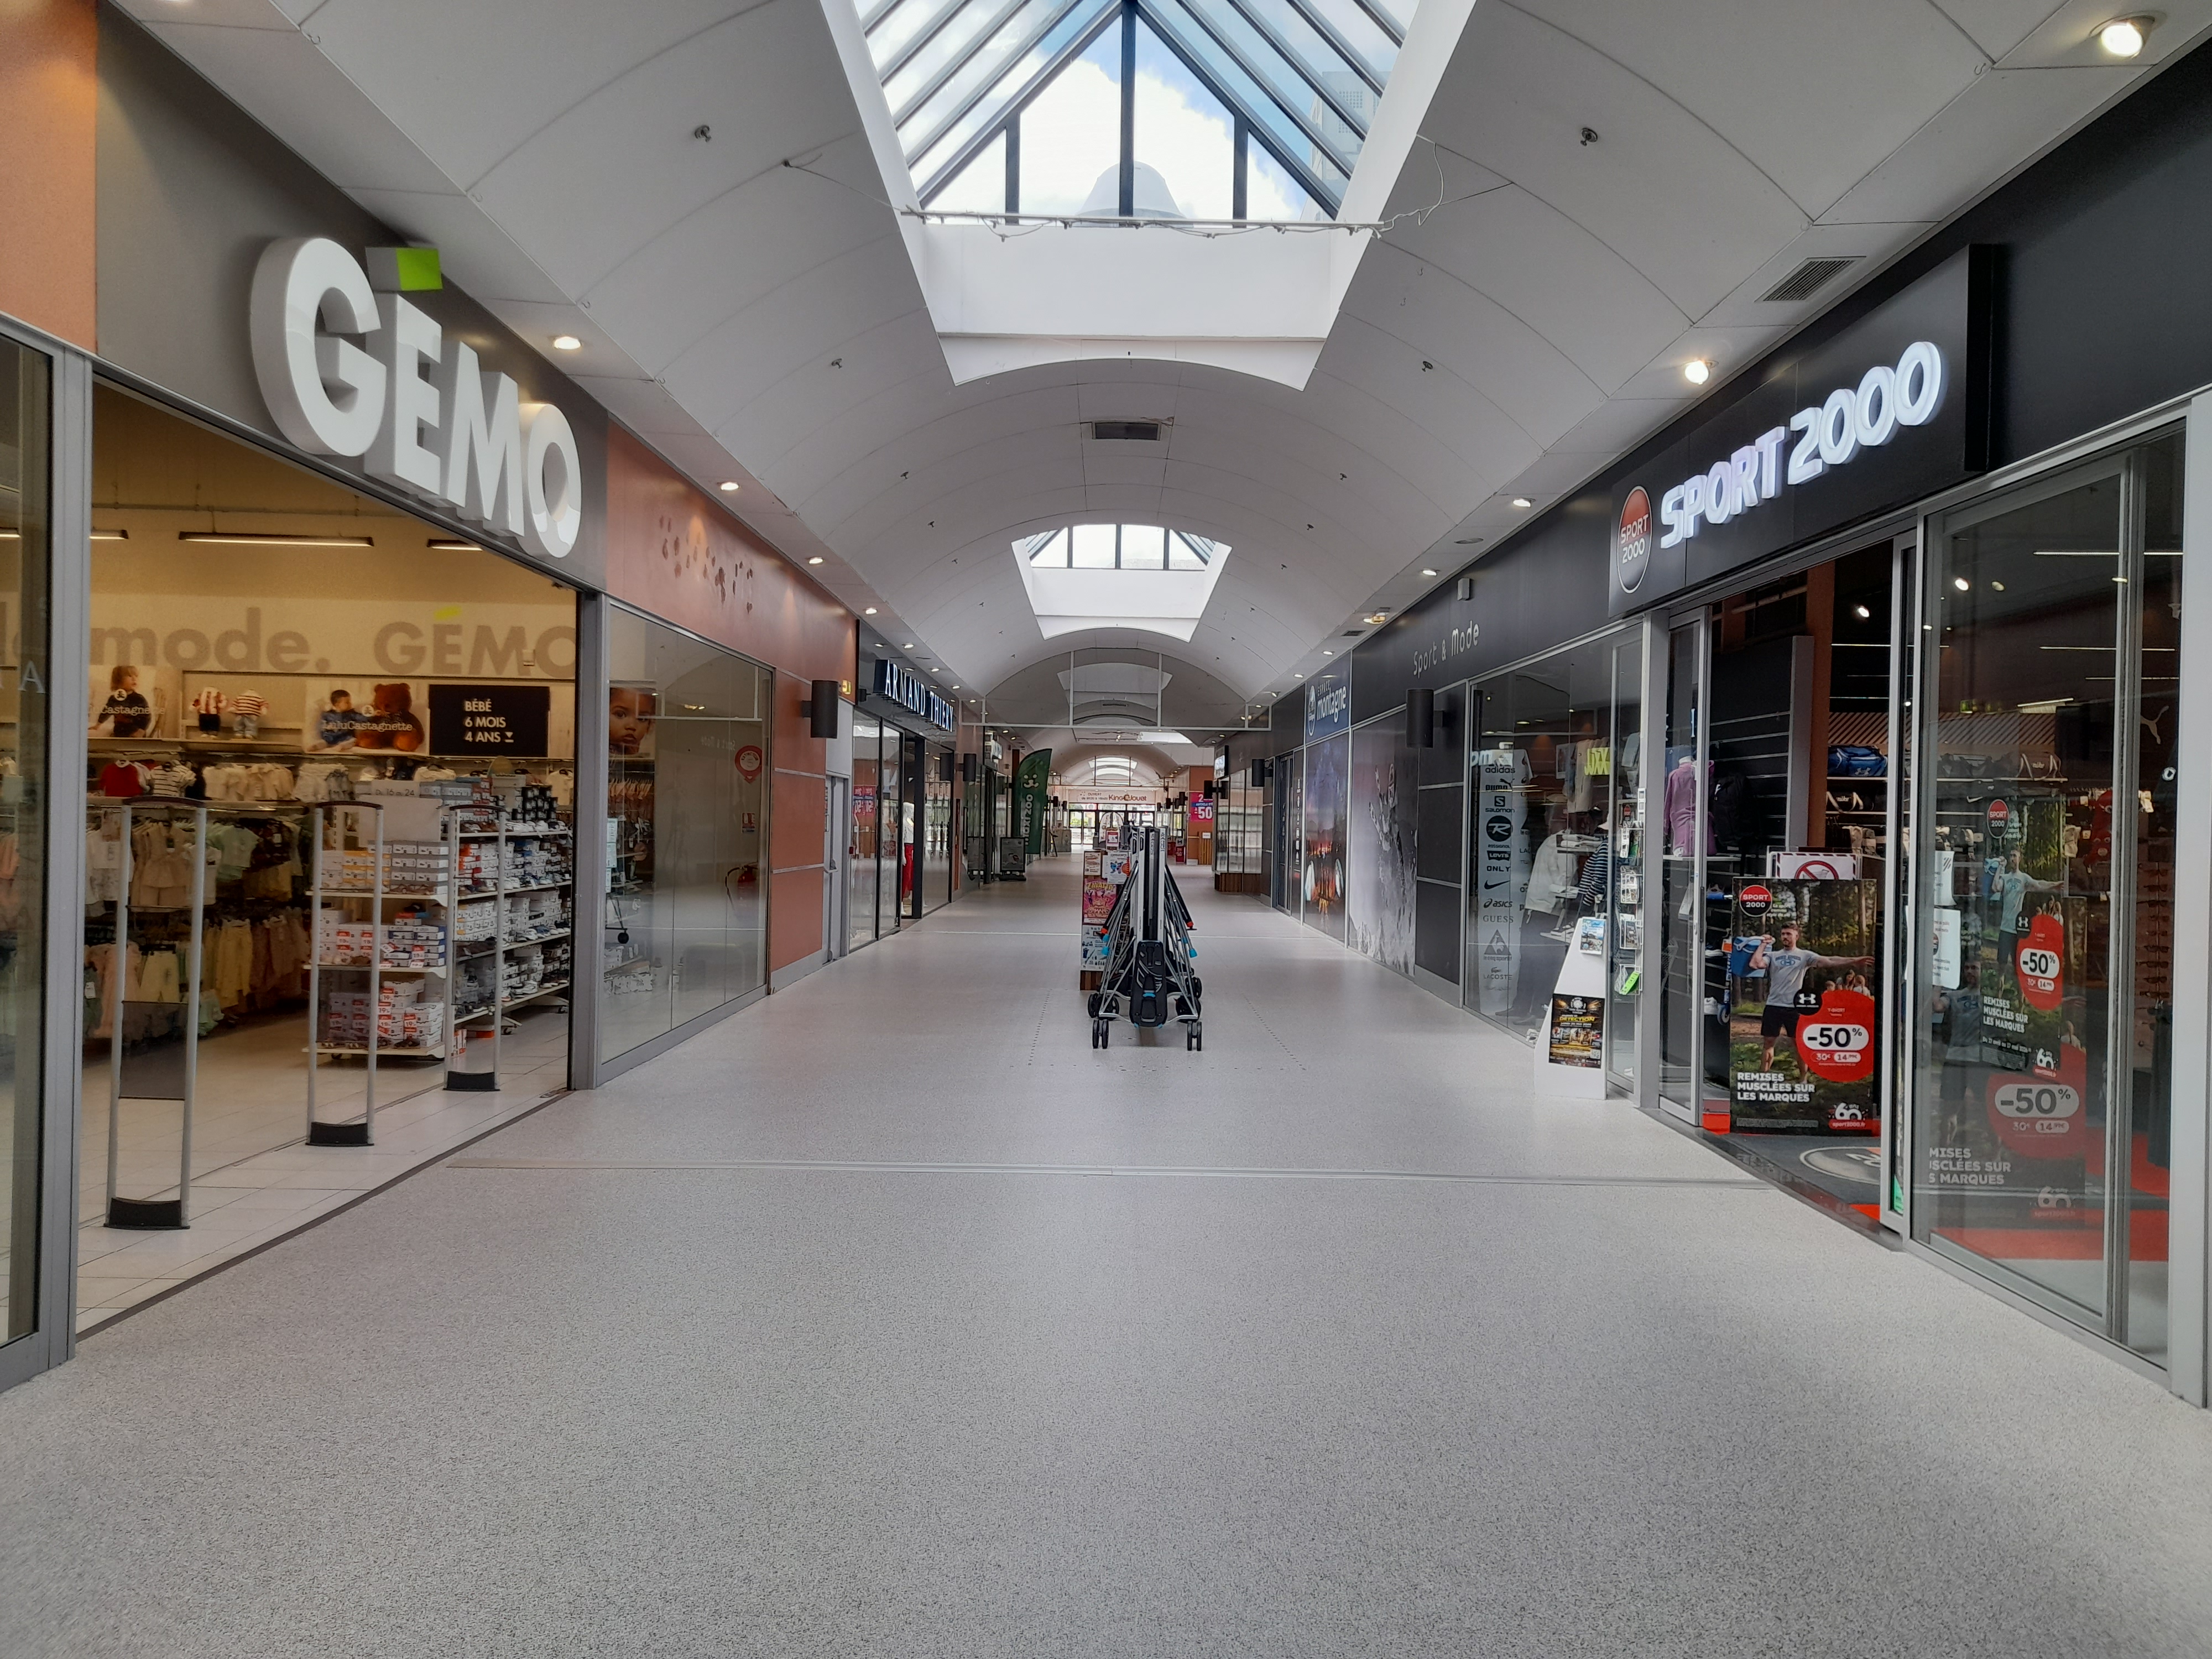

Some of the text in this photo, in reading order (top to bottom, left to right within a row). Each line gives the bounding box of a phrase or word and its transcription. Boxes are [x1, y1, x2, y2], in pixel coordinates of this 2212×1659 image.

[1661, 341, 1942, 549] SPORT 2000
[1620, 513, 1649, 544] SPORT
[1622, 538, 1645, 564] 2000
[1413, 641, 1437, 679] Sport
[1442, 639, 1447, 661] &
[885, 659, 953, 732] ARMAND THIERY
[1318, 680, 1330, 697] ESPACE
[465, 698, 492, 712] BÉBÉ
[1317, 686, 1346, 723] montagne
[465, 717, 506, 728] 6 MOIS
[465, 732, 501, 743] 4 ANS
[1483, 915, 1514, 923] GUESS
[2023, 952, 2055, 974] -50%
[1983, 996, 2010, 1009] REMISES
[1983, 1006, 2028, 1024] MUSCLÉES SUR
[1983, 1016, 2025, 1034] LES MARQUES
[1807, 1027, 1863, 1047] -50%
[1737, 1072, 1785, 1082] REMISES
[1737, 1081, 1815, 1093] MUSCLÉES SUR
[1737, 1092, 1810, 1103] LES MARQUES
[2000, 1088, 2071, 1114] -50%
[1929, 1159, 2011, 1172] SCLÉES SUR
[1940, 1173, 2005, 1186] MARQUES
